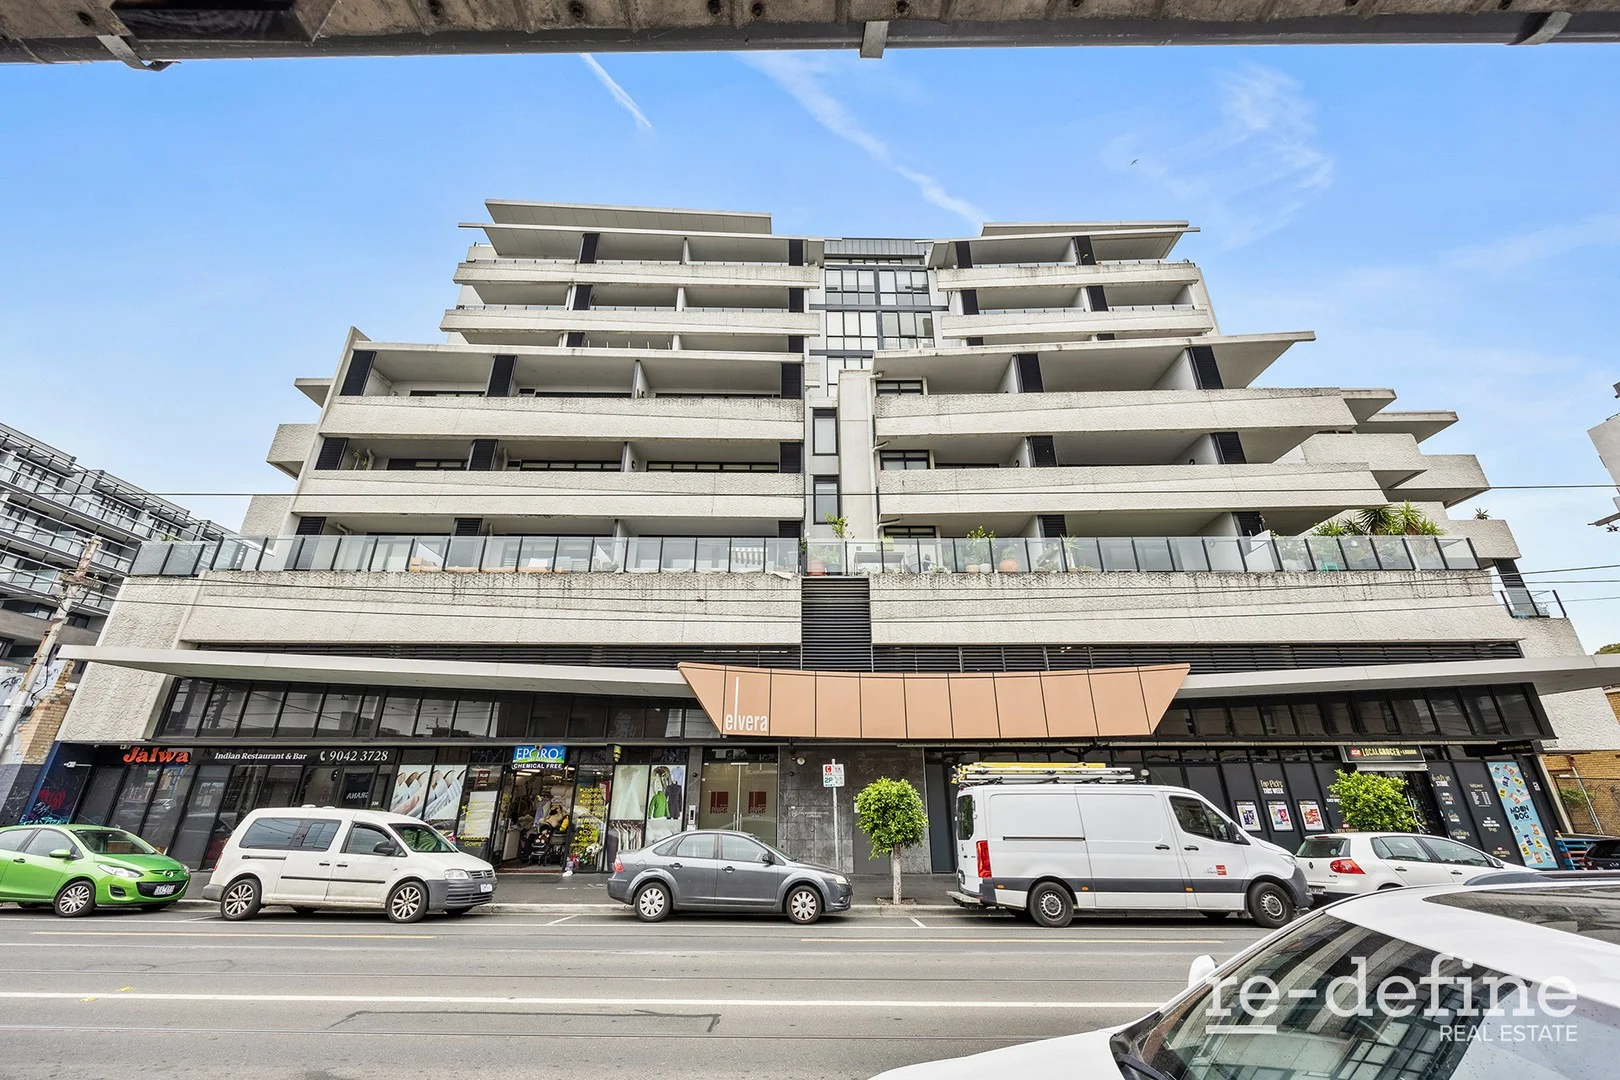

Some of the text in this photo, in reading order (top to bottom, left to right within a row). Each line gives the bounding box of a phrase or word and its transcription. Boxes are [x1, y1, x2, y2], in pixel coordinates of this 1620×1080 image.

[725, 676, 768, 732] elvera
[123, 747, 189, 763] Jalwa
[214, 750, 389, 761] Indian Restaurant & Bar 9042 3728
[516, 748, 559, 760] EPORO
[1361, 748, 1380, 757] LOCAL
[1379, 748, 1402, 757] GROCER
[1510, 805, 1530, 814] MOON
[1514, 812, 1530, 821] DOG
